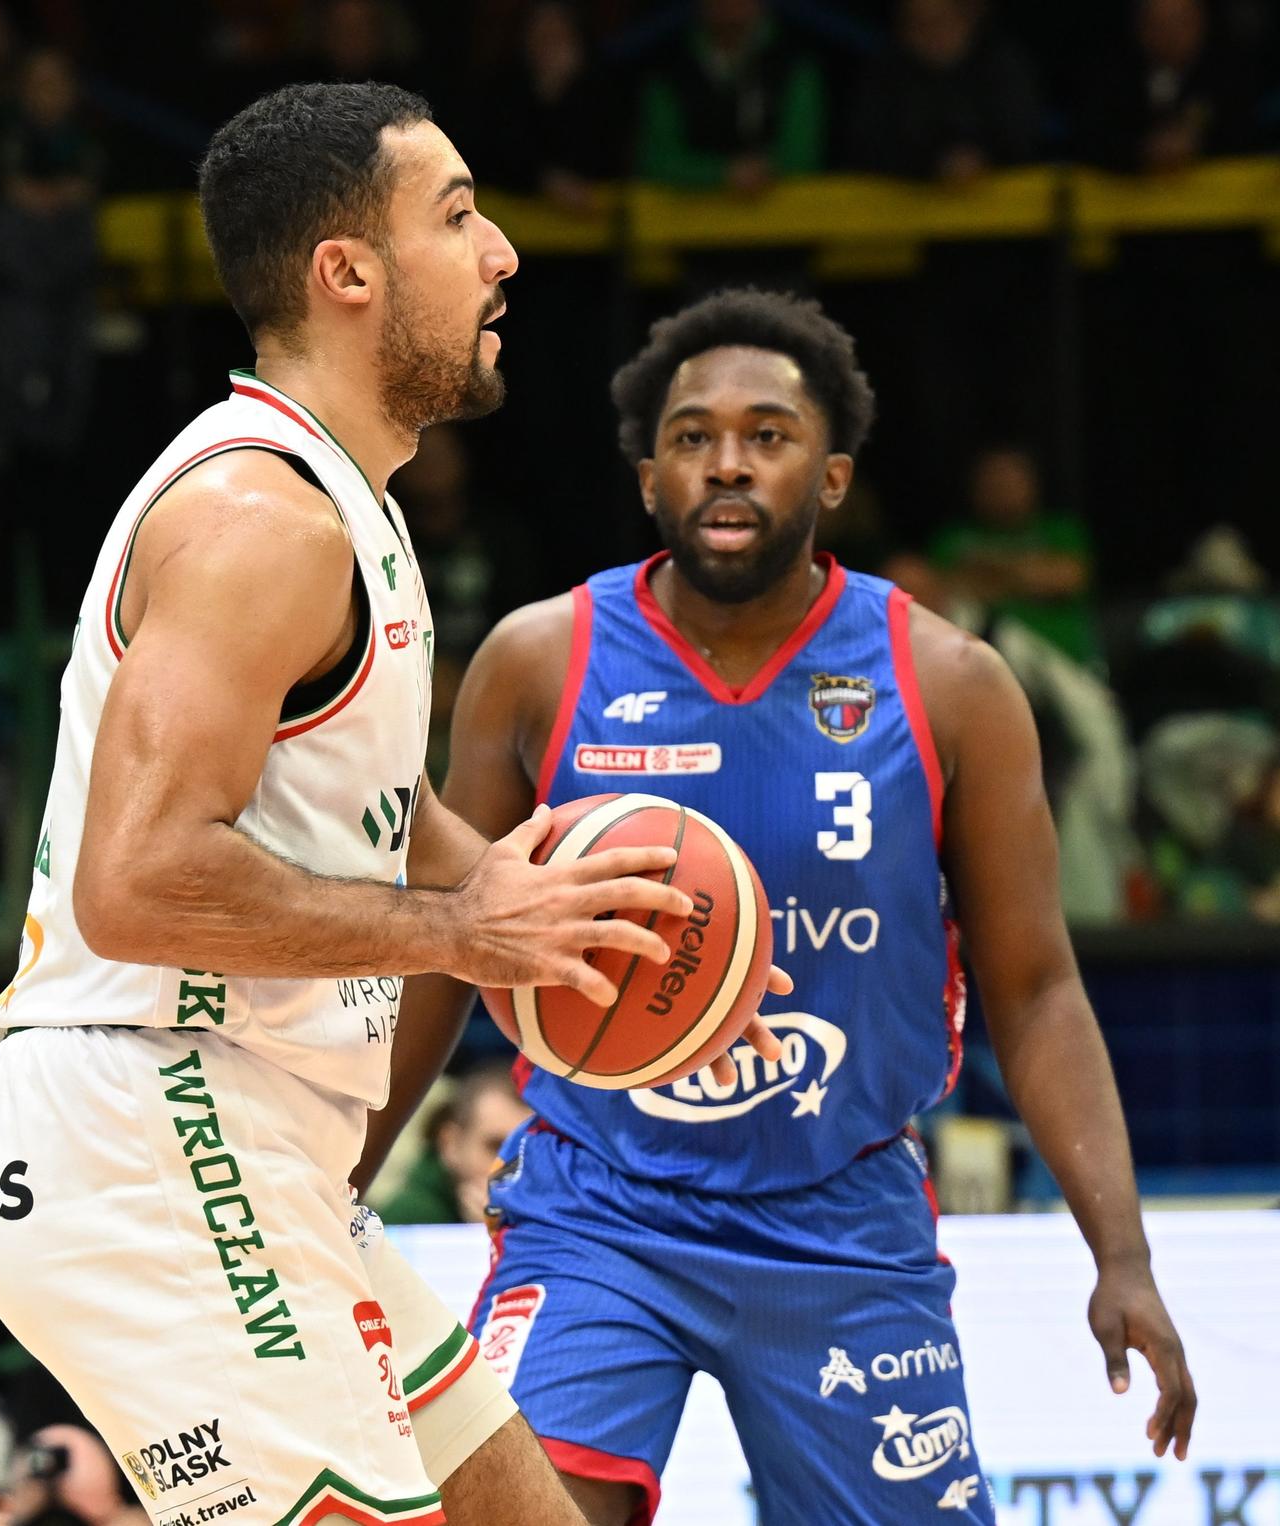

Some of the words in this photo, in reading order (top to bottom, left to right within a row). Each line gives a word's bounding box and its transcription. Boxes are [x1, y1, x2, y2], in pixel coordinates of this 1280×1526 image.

[603, 691, 668, 723] 4F
[580, 750, 642, 768] ORLEN
[815, 772, 872, 859] 3
[646, 888, 715, 1017] molten
[177, 968, 226, 1025] K
[159, 1050, 306, 1362] WROCŁAW
[871, 1340, 960, 1382] arriva
[140, 1418, 221, 1469] DOLNY
[894, 1417, 960, 1467] LOTTO
[937, 1474, 980, 1510] 4F
[1008, 1472, 1159, 1526] TY
